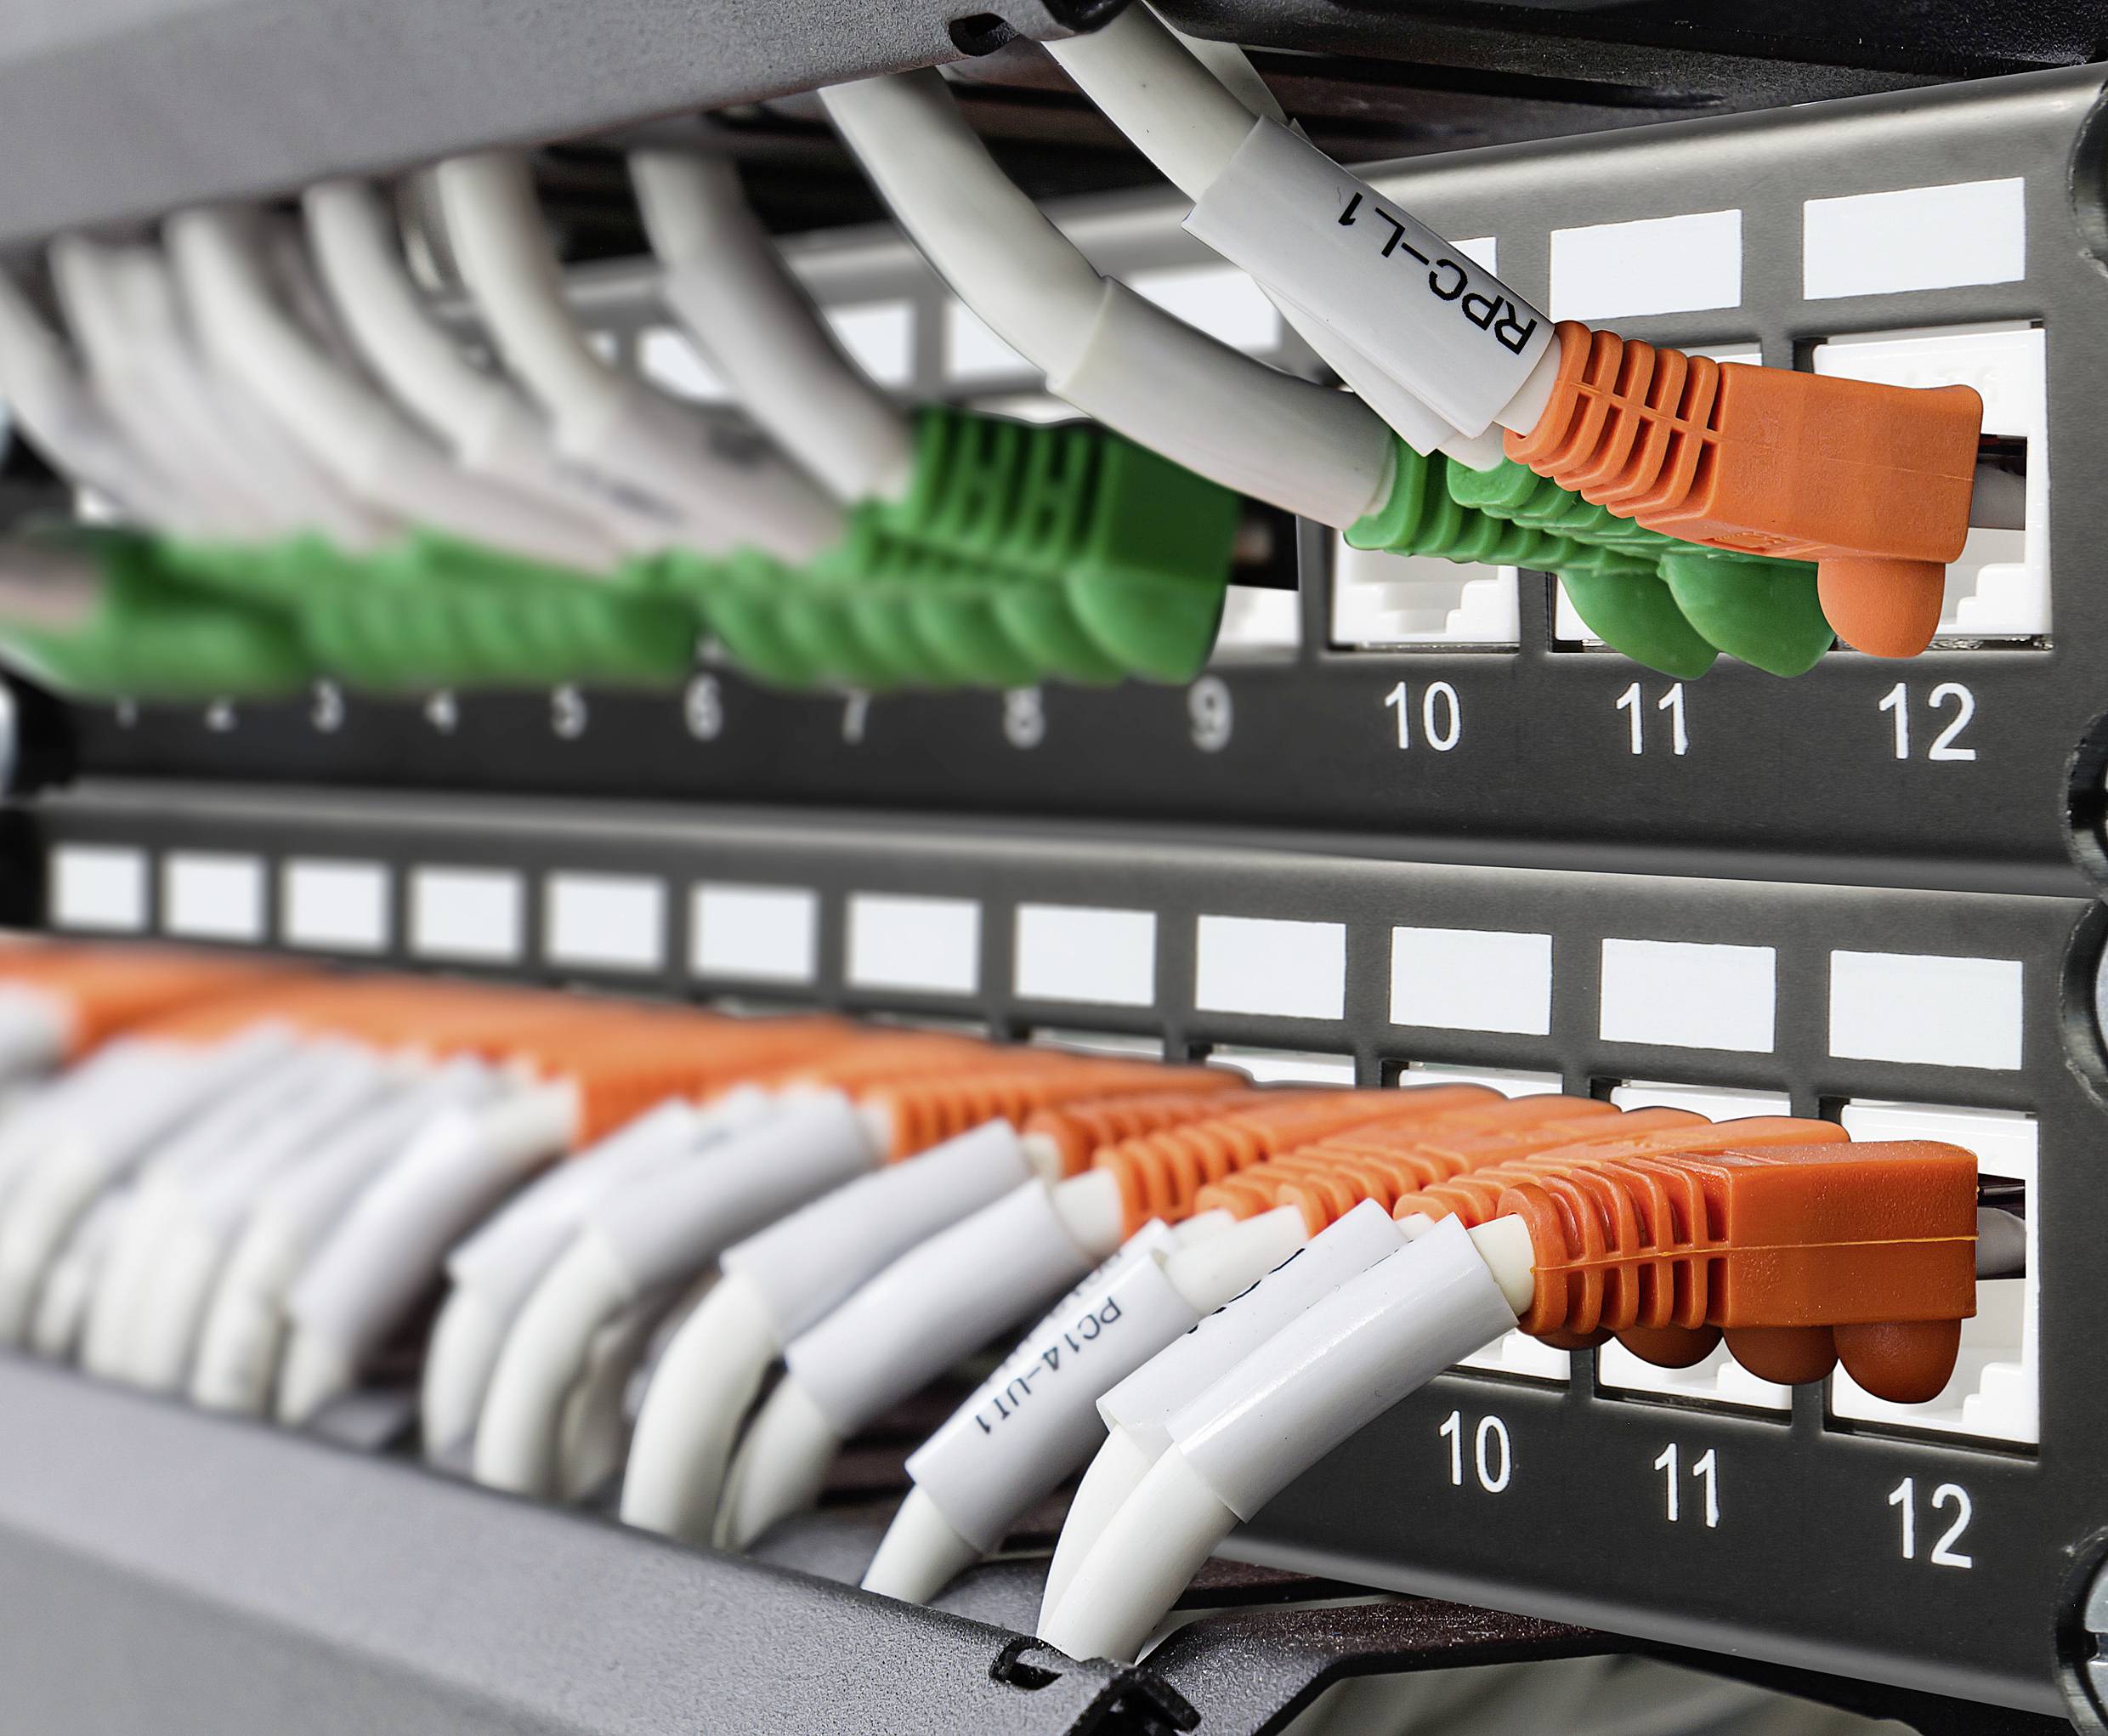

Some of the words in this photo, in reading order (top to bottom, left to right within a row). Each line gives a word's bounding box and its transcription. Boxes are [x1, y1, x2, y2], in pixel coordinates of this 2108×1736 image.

[1338, 192, 1538, 355] RPC-L1
[1004, 683, 1045, 748] 8
[1188, 676, 1232, 752] 9
[1384, 681, 1461, 752] 10
[1616, 682, 1689, 756] 11
[1878, 682, 1977, 761] 12
[1439, 1410, 1511, 1493] 10
[1654, 1443, 1720, 1528] 11
[1888, 1477, 1973, 1569] 12
